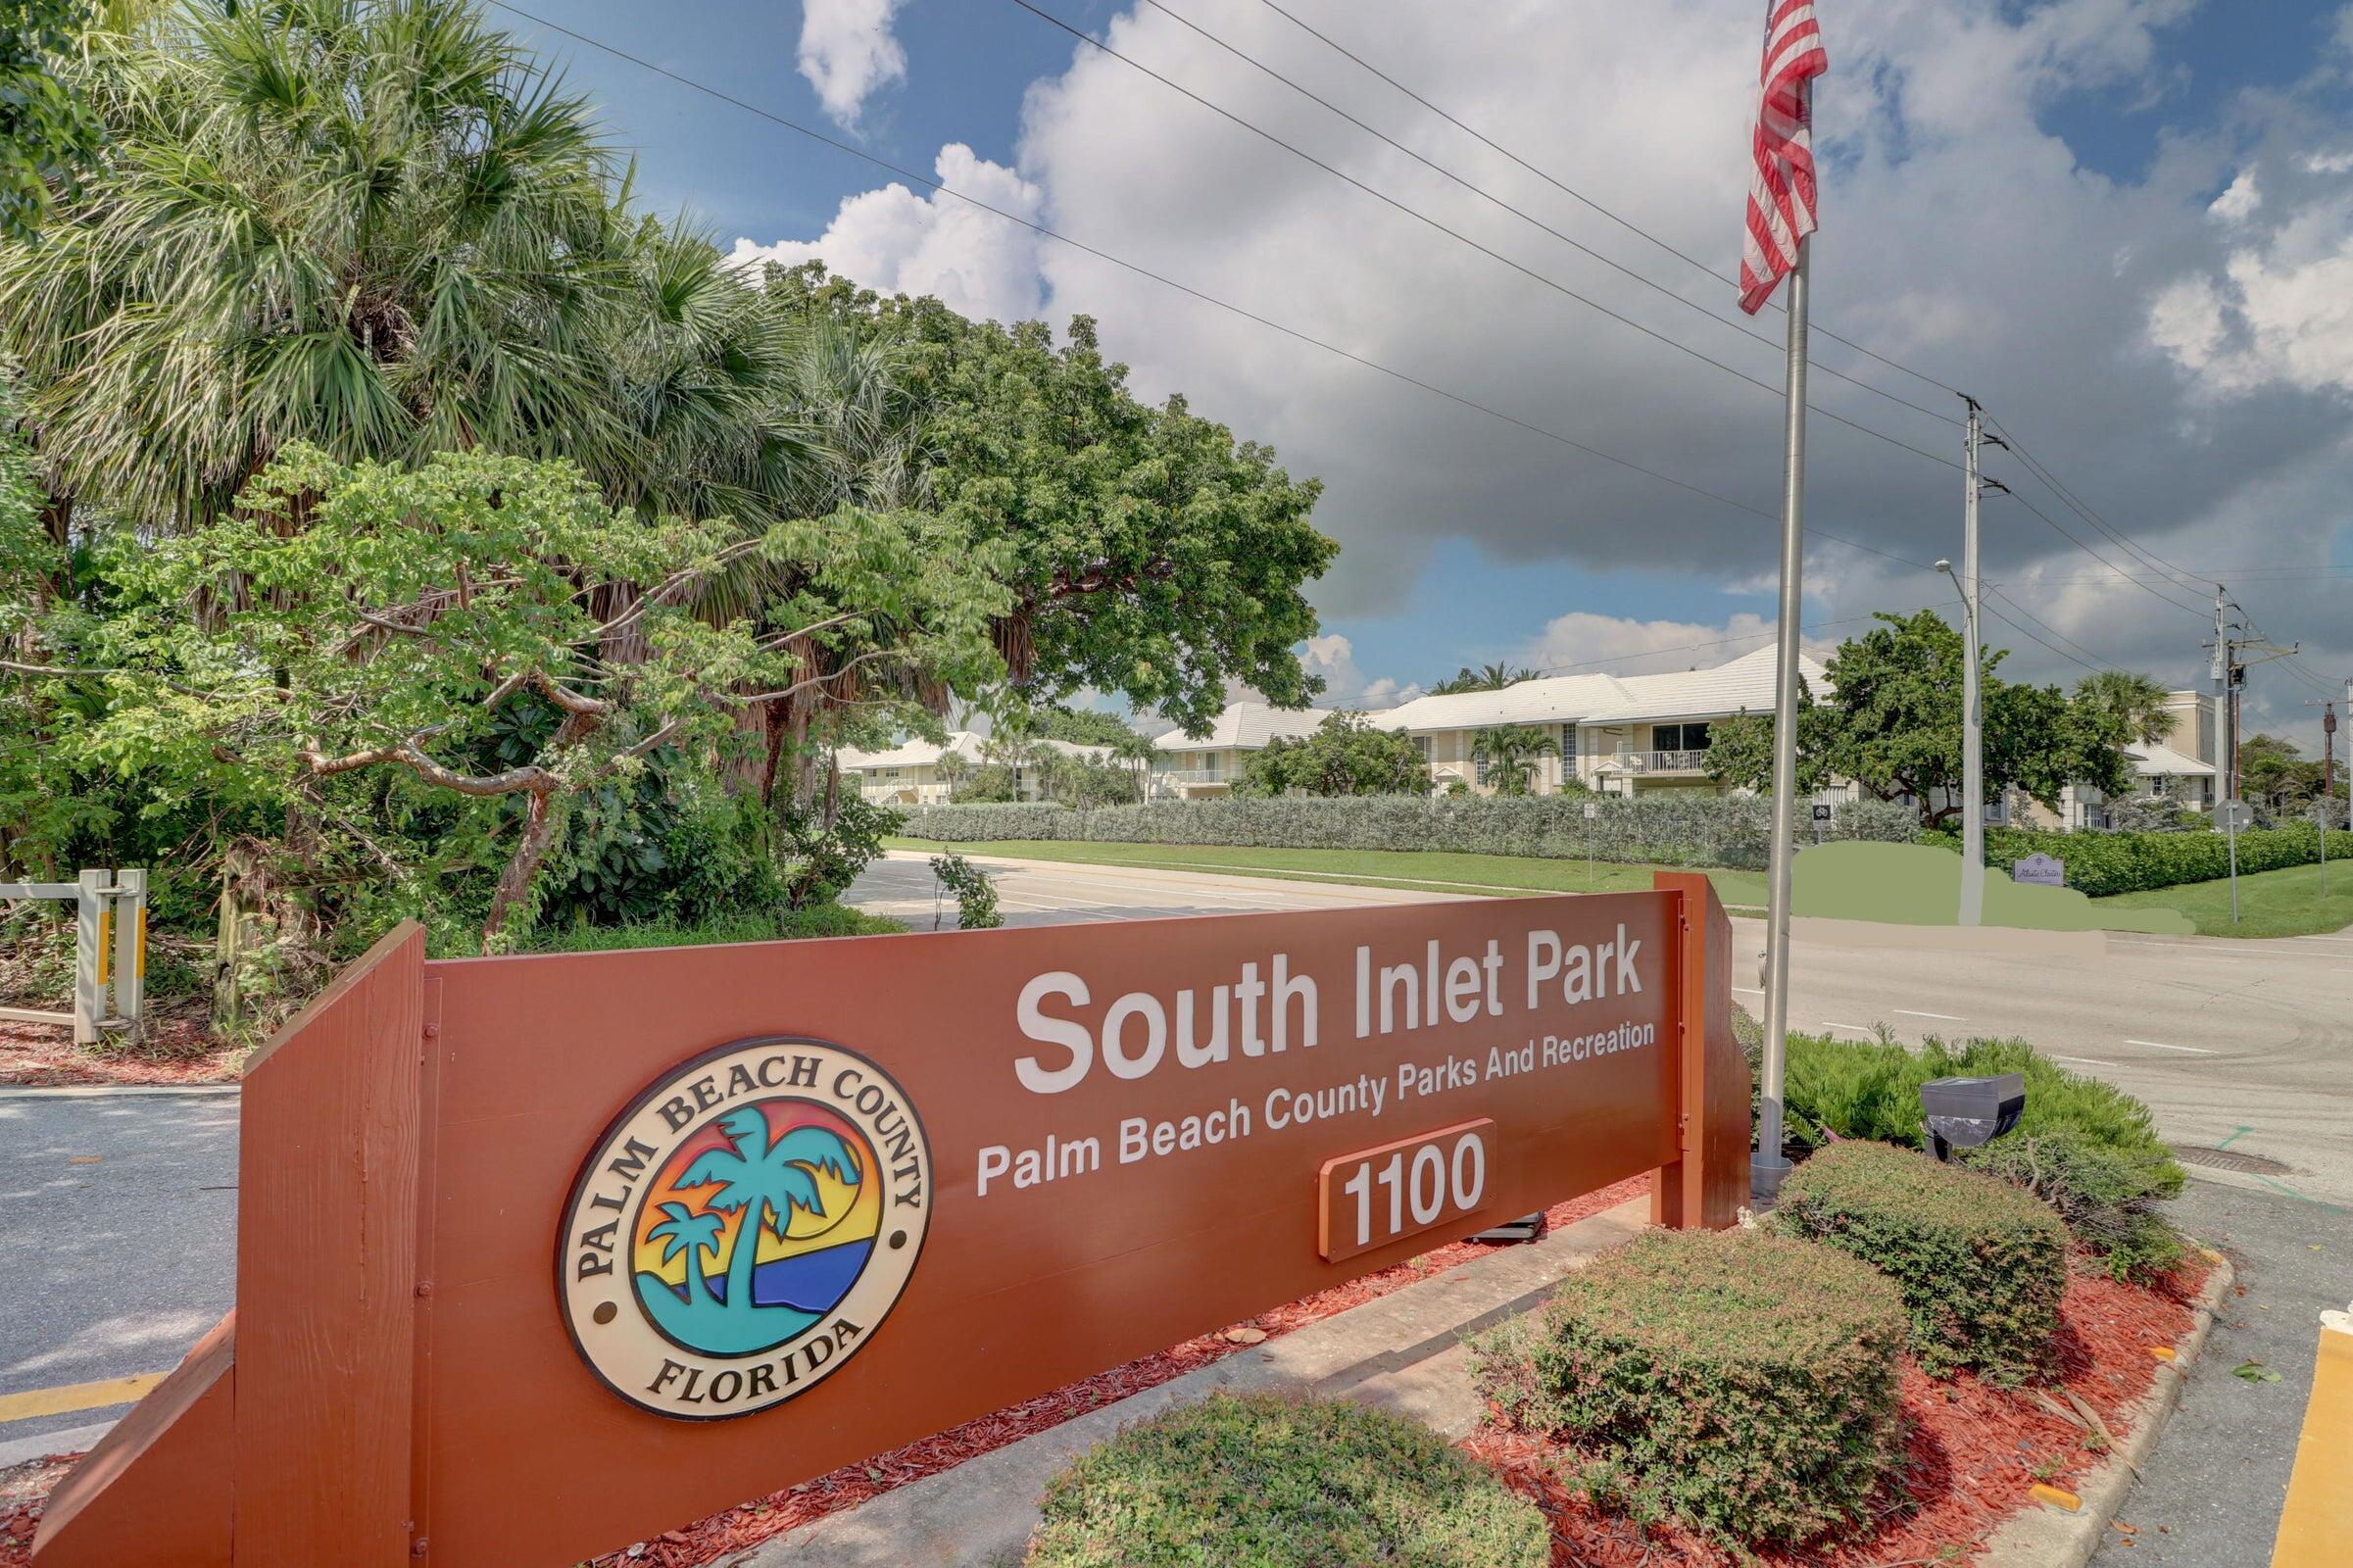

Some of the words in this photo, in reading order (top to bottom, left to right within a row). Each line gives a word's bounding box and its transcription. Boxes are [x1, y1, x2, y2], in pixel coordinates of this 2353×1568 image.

[1014, 953, 1318, 1094] South
[1356, 939, 1504, 1039] Inlet
[1527, 923, 1642, 1009] Park
[577, 1135, 659, 1283] PALM
[656, 1055, 823, 1135] BEACH
[832, 1068, 922, 1209] COUNTY
[977, 1134, 1100, 1197] Palm
[1119, 1098, 1250, 1164] Beach
[1264, 1074, 1387, 1130] County
[1397, 1054, 1477, 1101] Parks
[1485, 1040, 1534, 1081] And
[1543, 1020, 1654, 1068] Recreation
[1345, 1133, 1485, 1246] 1100
[646, 1317, 864, 1404] FLORIDA
